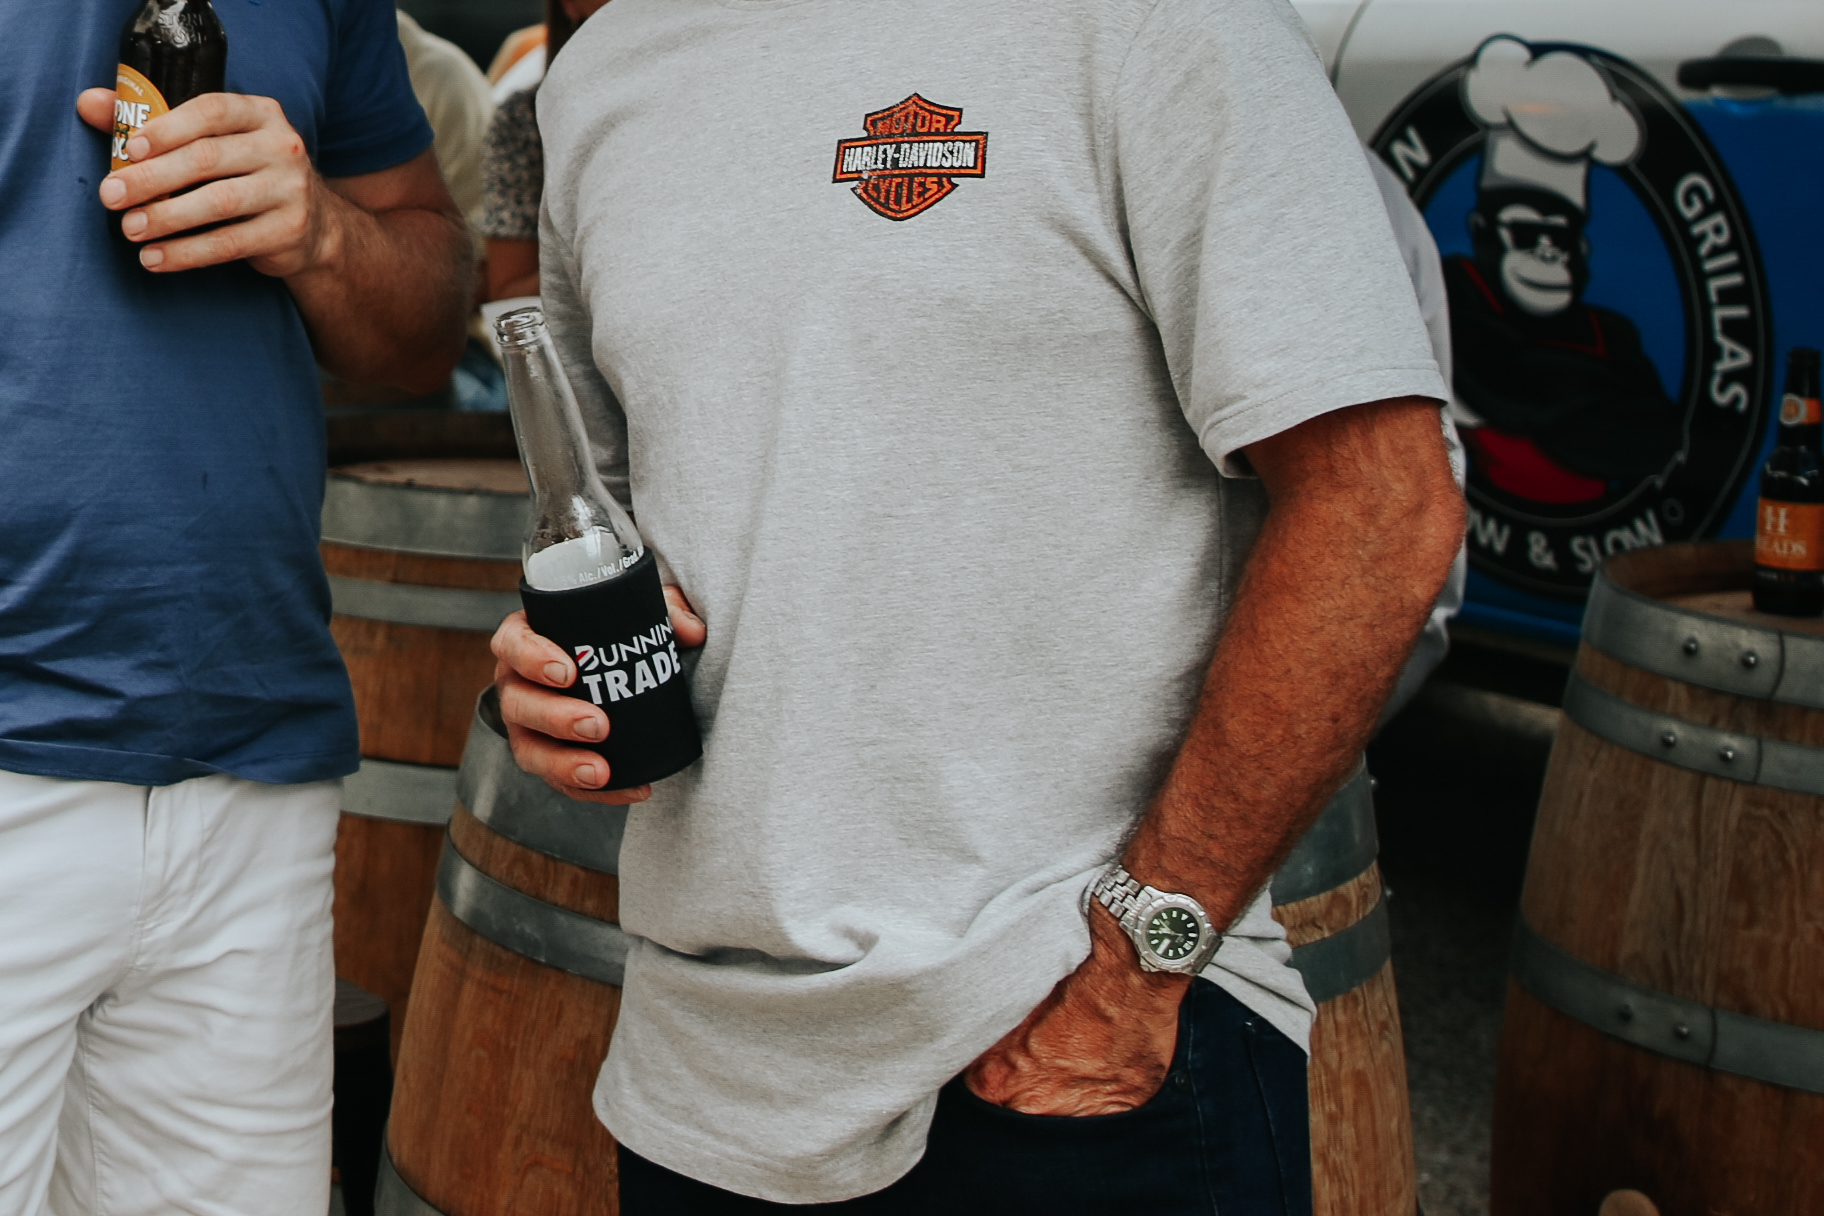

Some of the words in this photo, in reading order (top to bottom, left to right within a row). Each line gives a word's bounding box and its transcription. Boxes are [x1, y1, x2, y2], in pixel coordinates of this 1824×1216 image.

[876, 109, 947, 135] MOTOR
[842, 141, 976, 172] HARLEY-DAVIDSON
[866, 176, 940, 211] CYCLES
[1674, 172, 1753, 414] GRILLAS
[582, 640, 681, 705] TRADE
